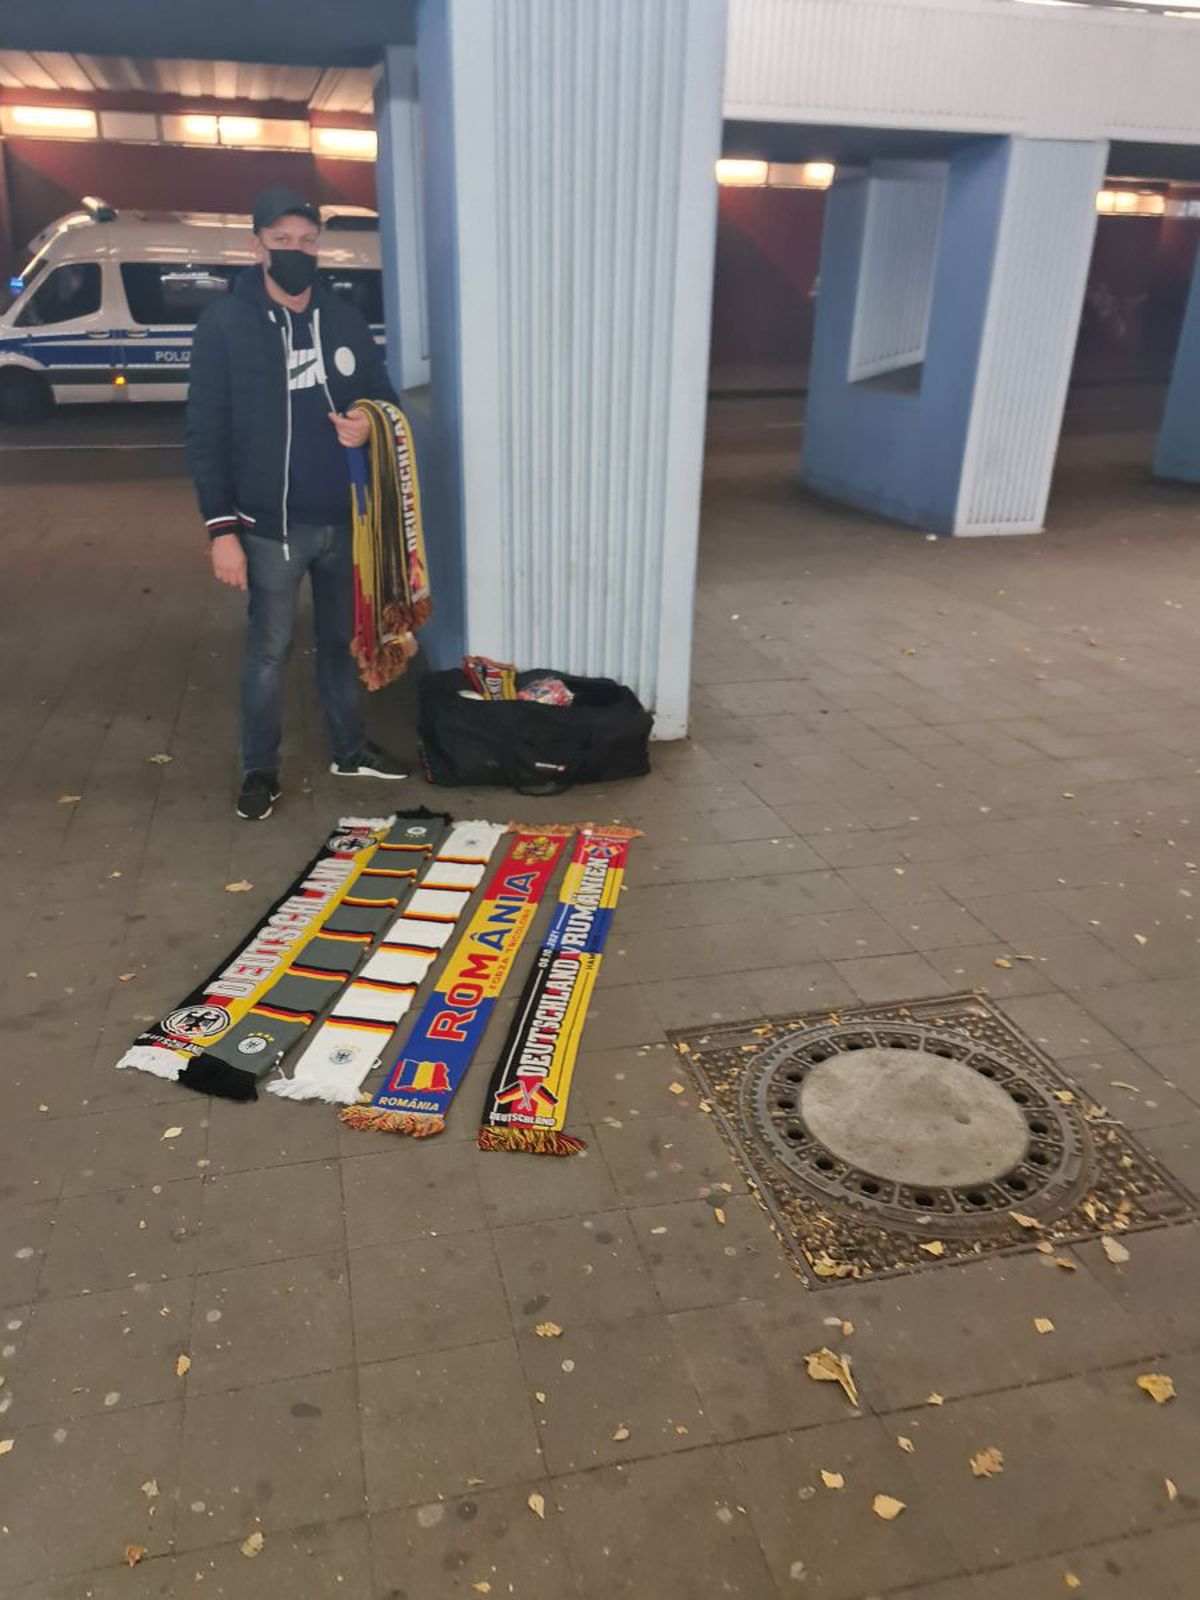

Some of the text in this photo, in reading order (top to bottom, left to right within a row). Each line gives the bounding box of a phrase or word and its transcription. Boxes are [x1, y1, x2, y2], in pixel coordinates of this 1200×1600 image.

[203, 857, 357, 1000] DEUTSCHLAND
[426, 872, 540, 1042] ROMÂNIA
[516, 959, 580, 1078] DEUTSCHLAND
[561, 857, 609, 947] RUMÄNIEN
[378, 1096, 440, 1111] ROMÂNIA
[489, 1111, 557, 1128] DEUTSCHLAND
